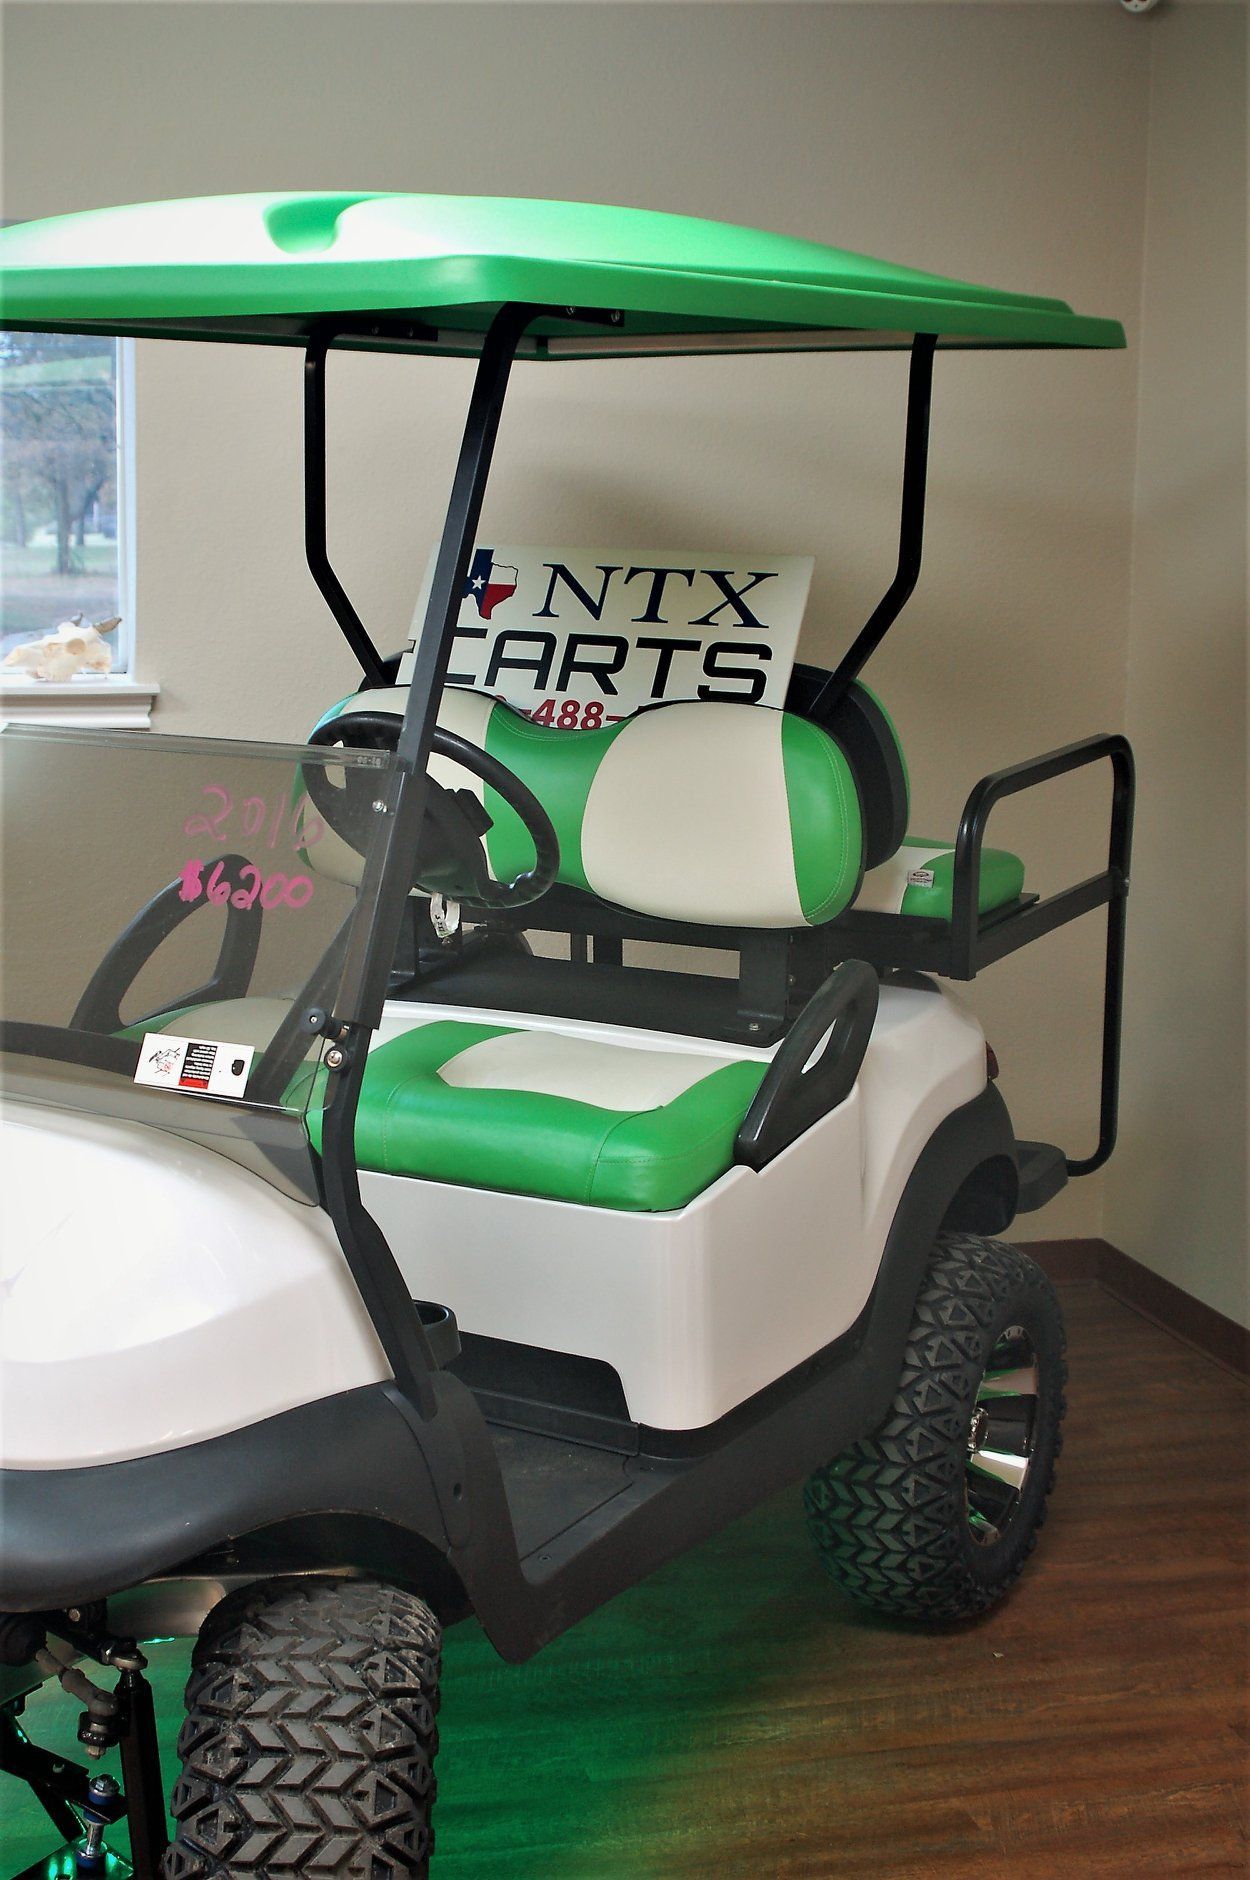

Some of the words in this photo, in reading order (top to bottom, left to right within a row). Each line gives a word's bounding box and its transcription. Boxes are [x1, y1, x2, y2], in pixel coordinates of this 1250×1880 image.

[532, 563, 779, 629] NTX
[183, 784, 325, 850] 2016
[179, 858, 314, 910] $6200
